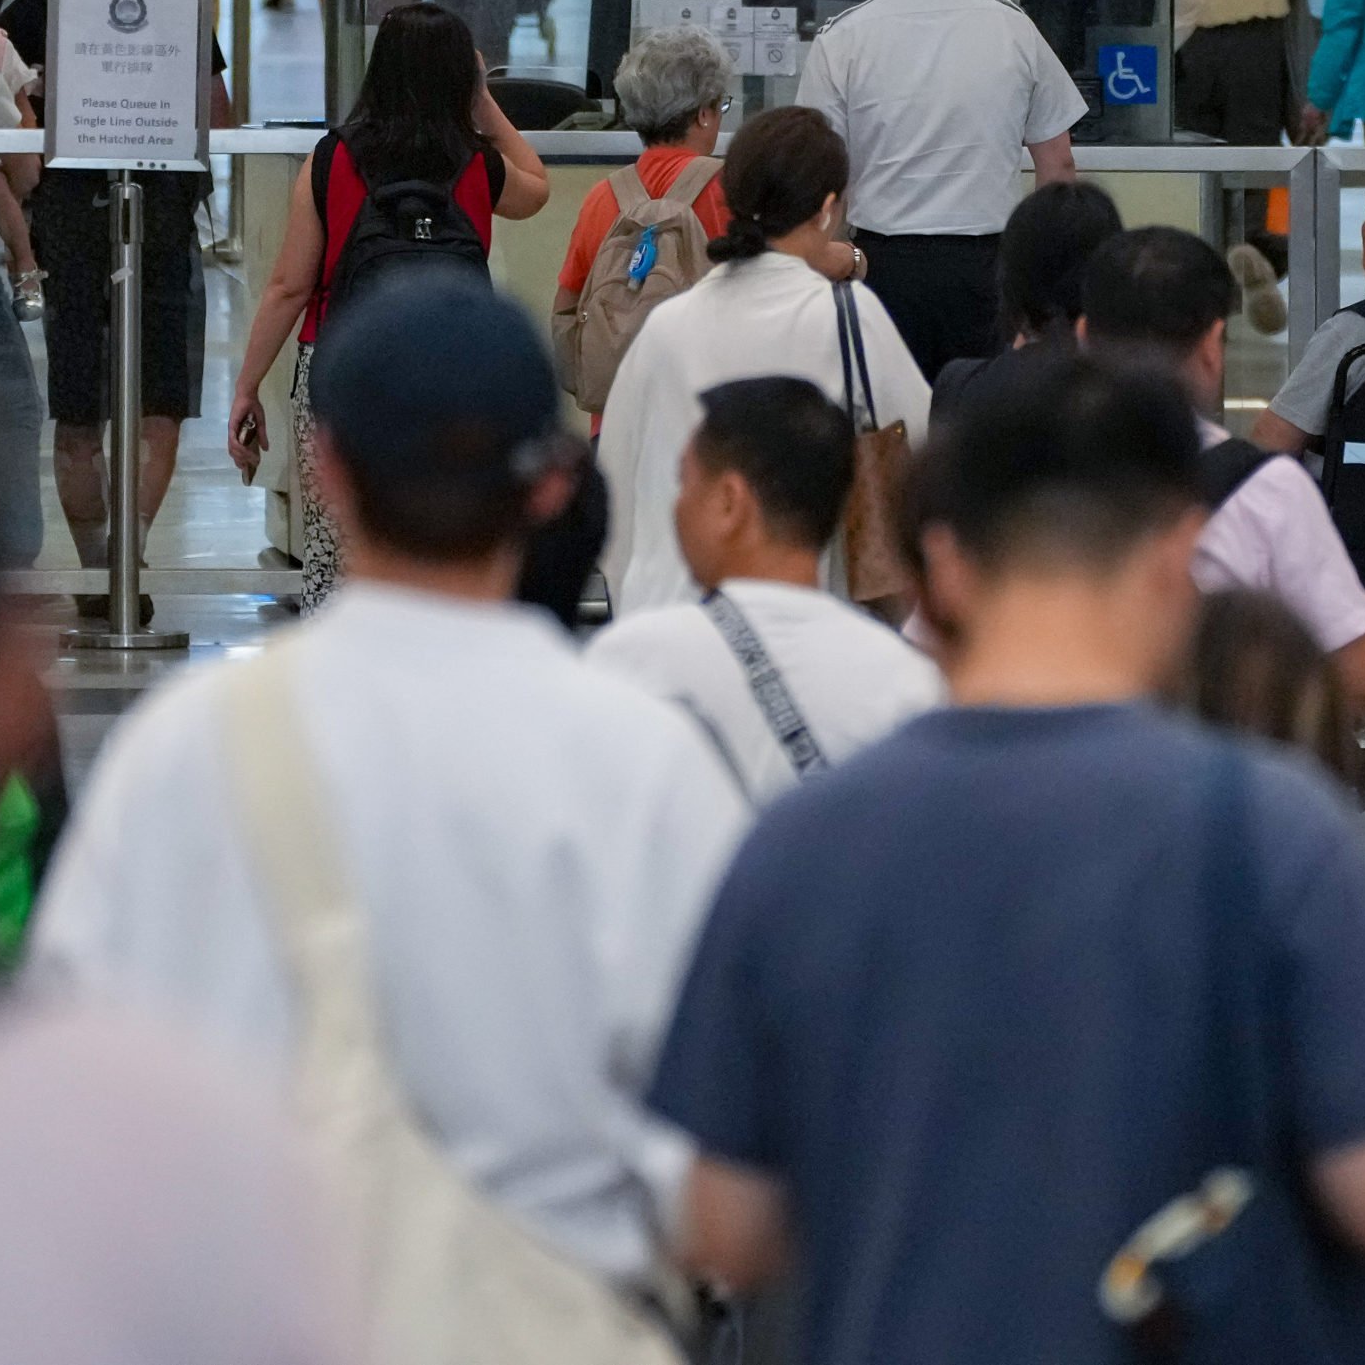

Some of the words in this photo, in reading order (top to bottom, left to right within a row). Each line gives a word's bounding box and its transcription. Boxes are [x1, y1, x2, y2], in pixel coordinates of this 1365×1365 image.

[81, 97, 118, 110] Please
[120, 99, 156, 112] Queue
[159, 100, 171, 110] In
[73, 116, 107, 129] Single
[109, 117, 132, 127] Line
[134, 117, 179, 128] Outside
[77, 134, 96, 145] the
[98, 135, 144, 146] Hatched
[147, 136, 175, 146] Area
